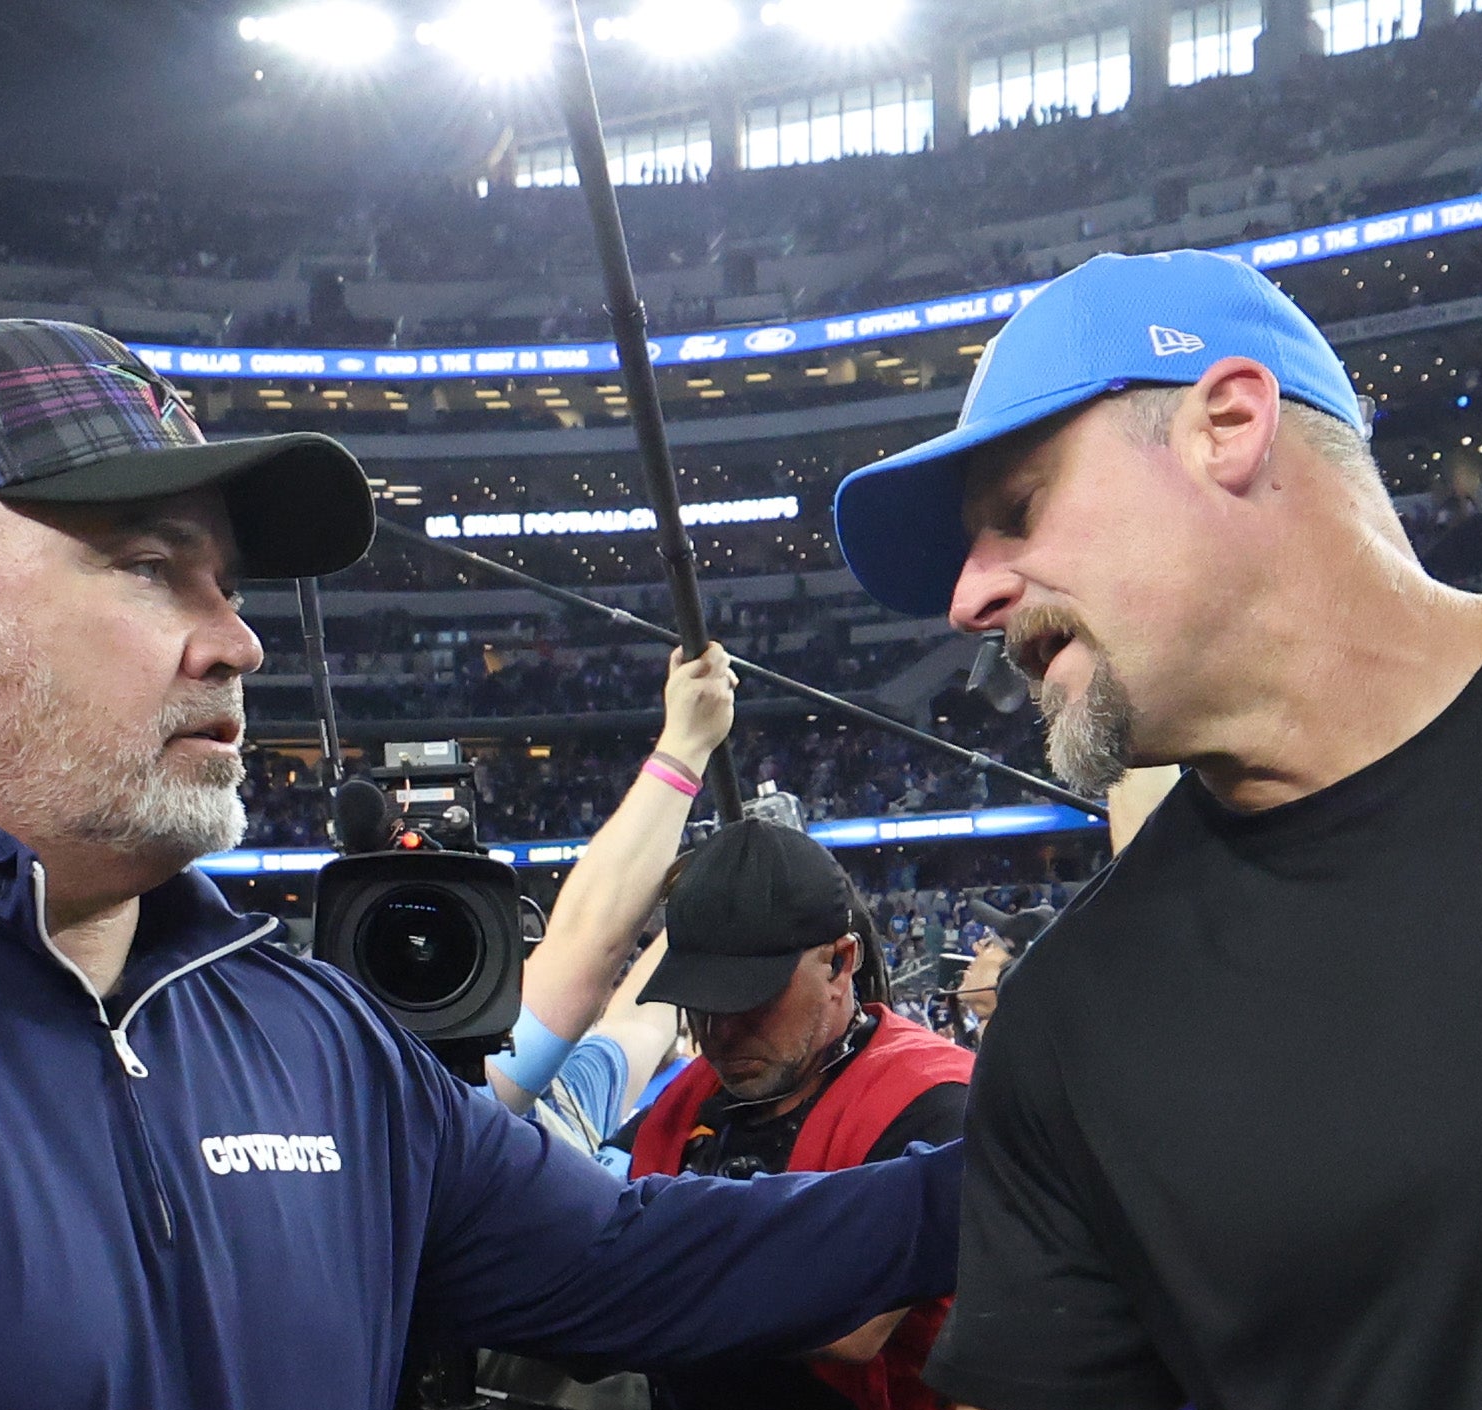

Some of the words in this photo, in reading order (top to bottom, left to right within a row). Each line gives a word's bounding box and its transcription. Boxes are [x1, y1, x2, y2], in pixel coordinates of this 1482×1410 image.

[1302, 235, 1319, 255] IS
[1323, 226, 1358, 250] THE
[1363, 216, 1409, 242] BEST
[1413, 211, 1434, 232] IN
[826, 320, 854, 340] THE
[857, 310, 920, 335] OFFICIAL
[925, 298, 987, 324] VEHICLE
[992, 292, 1014, 313] OF
[201, 1133, 342, 1175] COWBOYS
